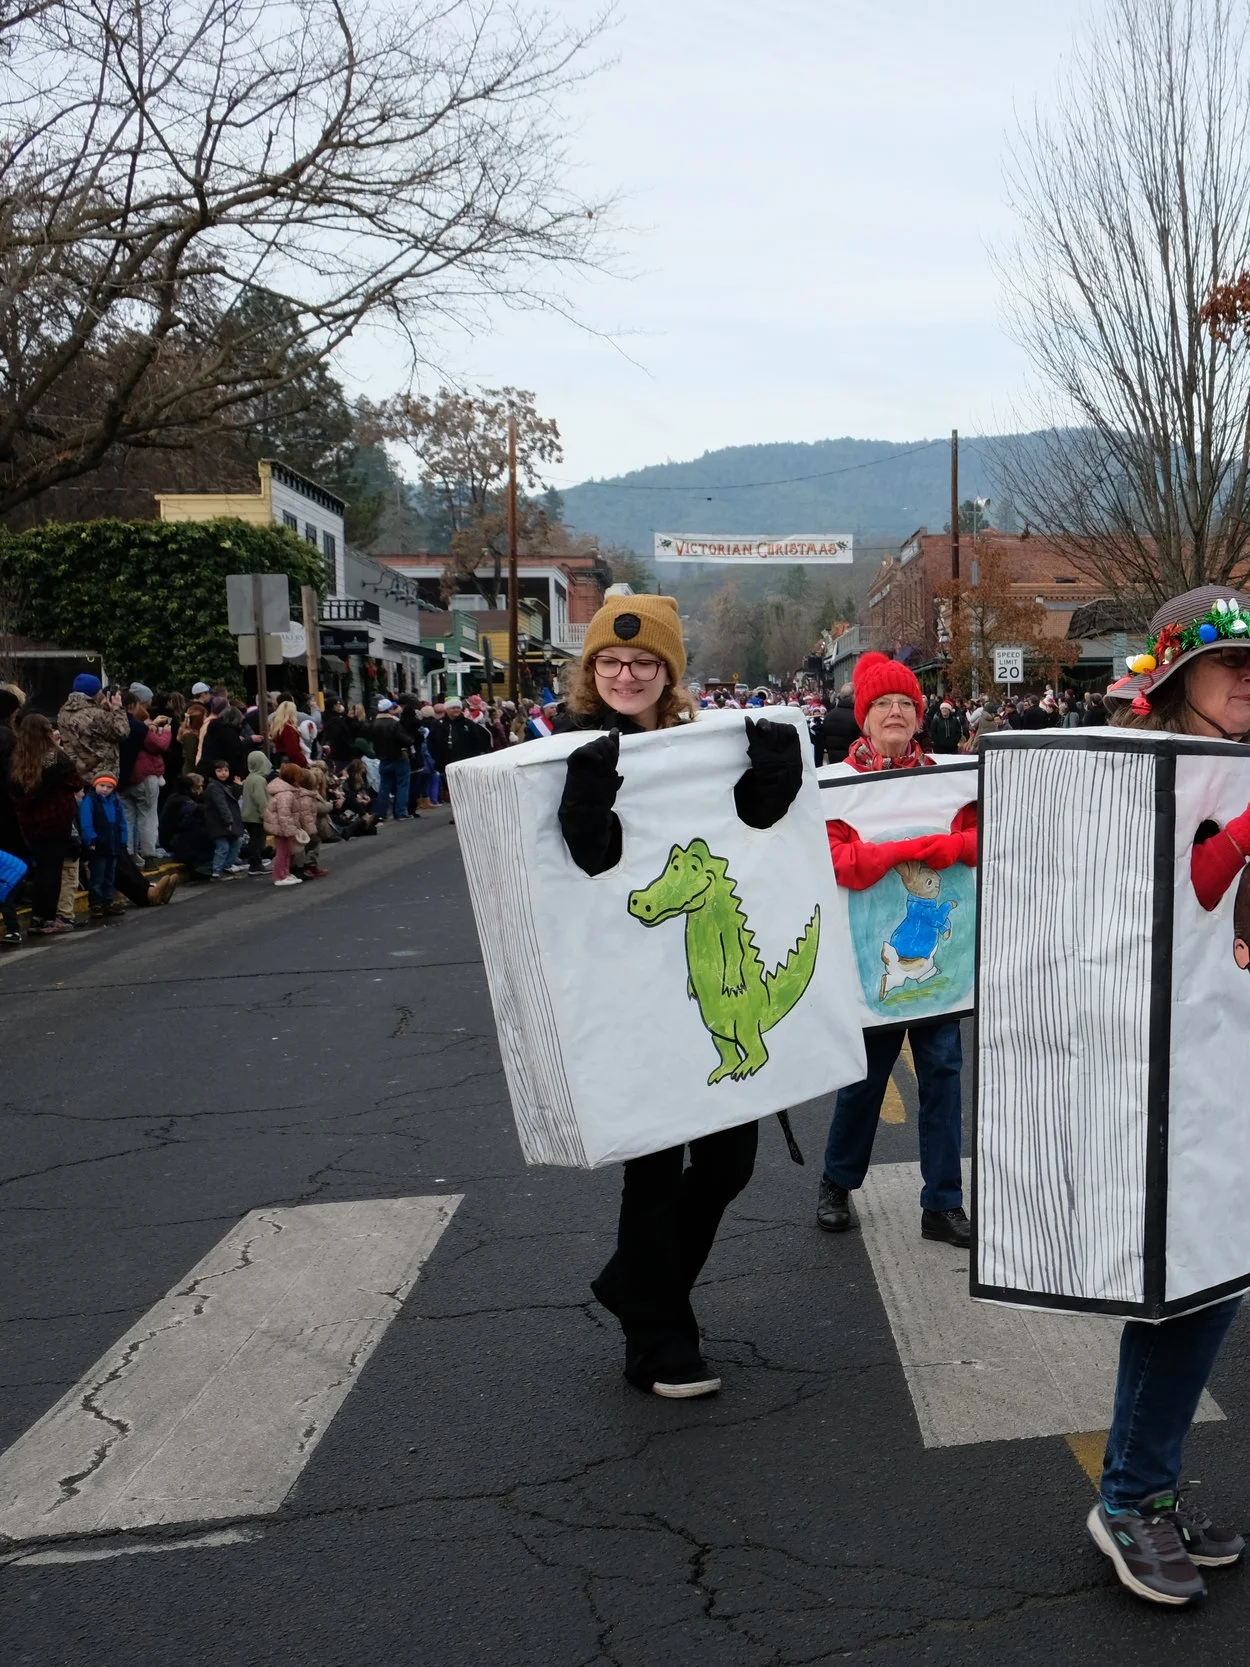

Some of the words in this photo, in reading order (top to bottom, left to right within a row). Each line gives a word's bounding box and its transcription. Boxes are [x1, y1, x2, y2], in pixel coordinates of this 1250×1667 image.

[675, 540, 753, 557] VICTORIAN
[757, 540, 838, 558] CHRISTMAS
[998, 666, 1019, 678] 20
